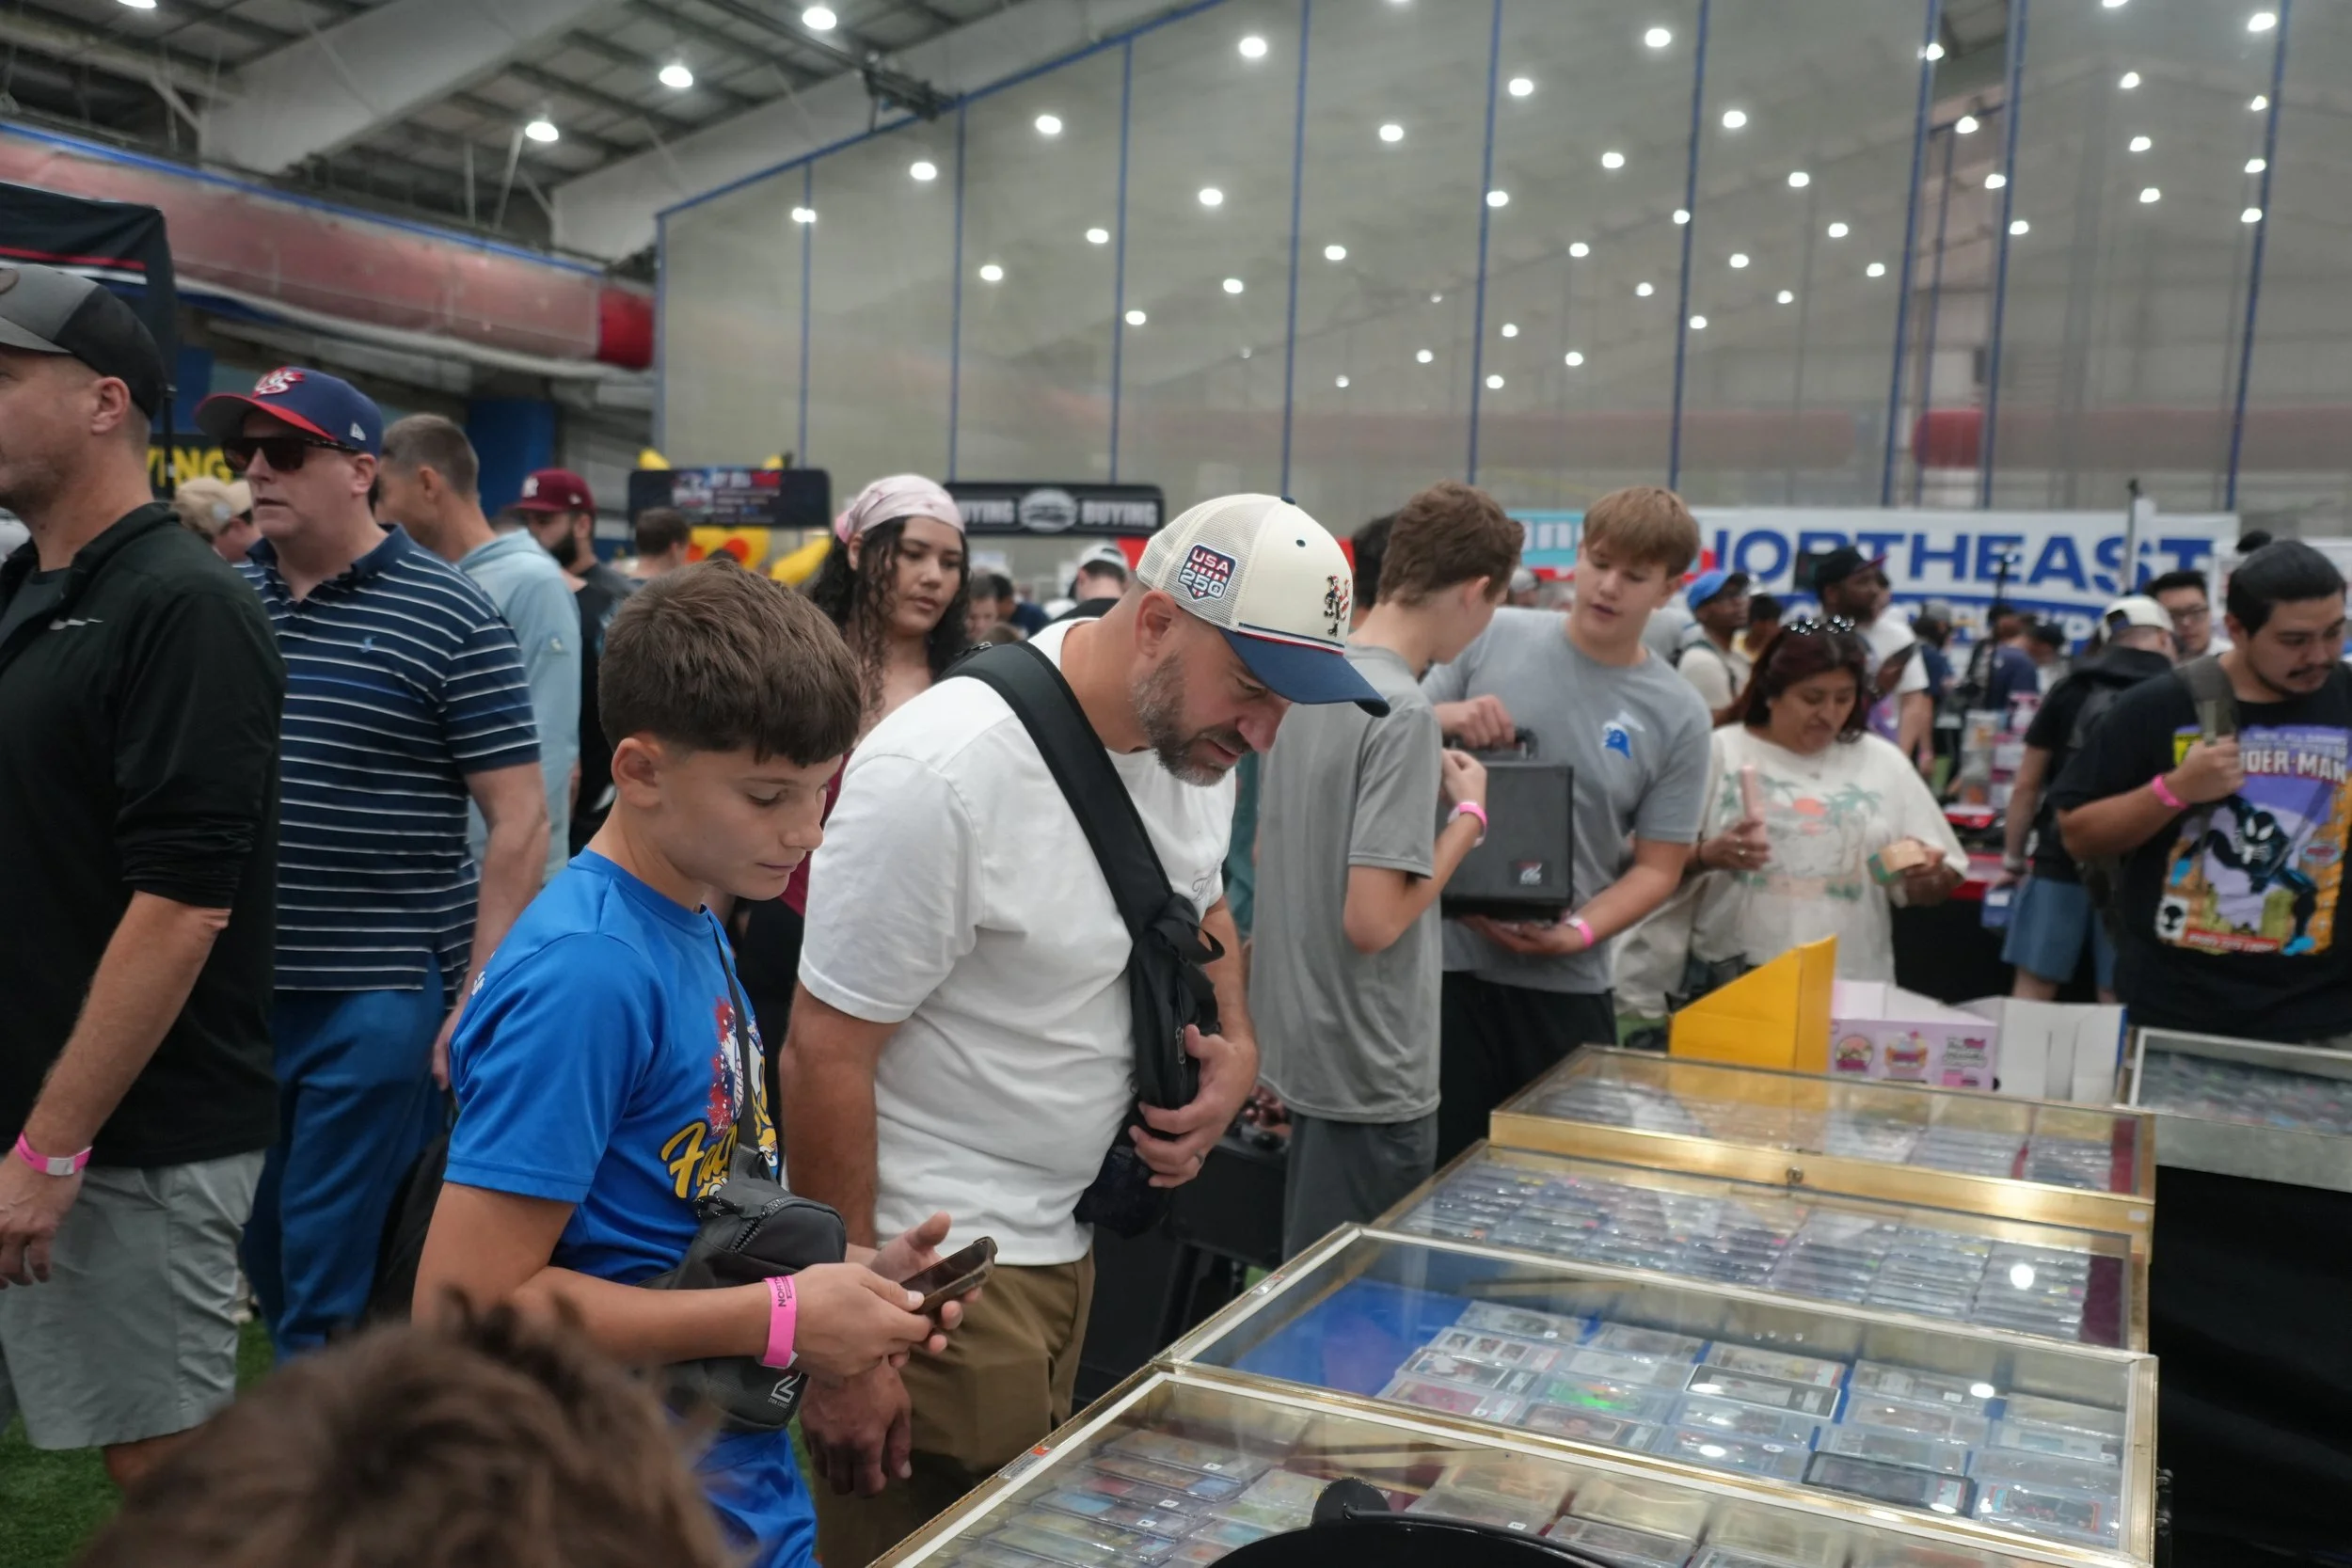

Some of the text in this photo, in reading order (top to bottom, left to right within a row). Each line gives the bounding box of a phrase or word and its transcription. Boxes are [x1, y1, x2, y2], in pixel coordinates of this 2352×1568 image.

[1083, 499, 1158, 528] BUYING
[1191, 548, 1230, 574] USA
[1180, 568, 1225, 596] 250
